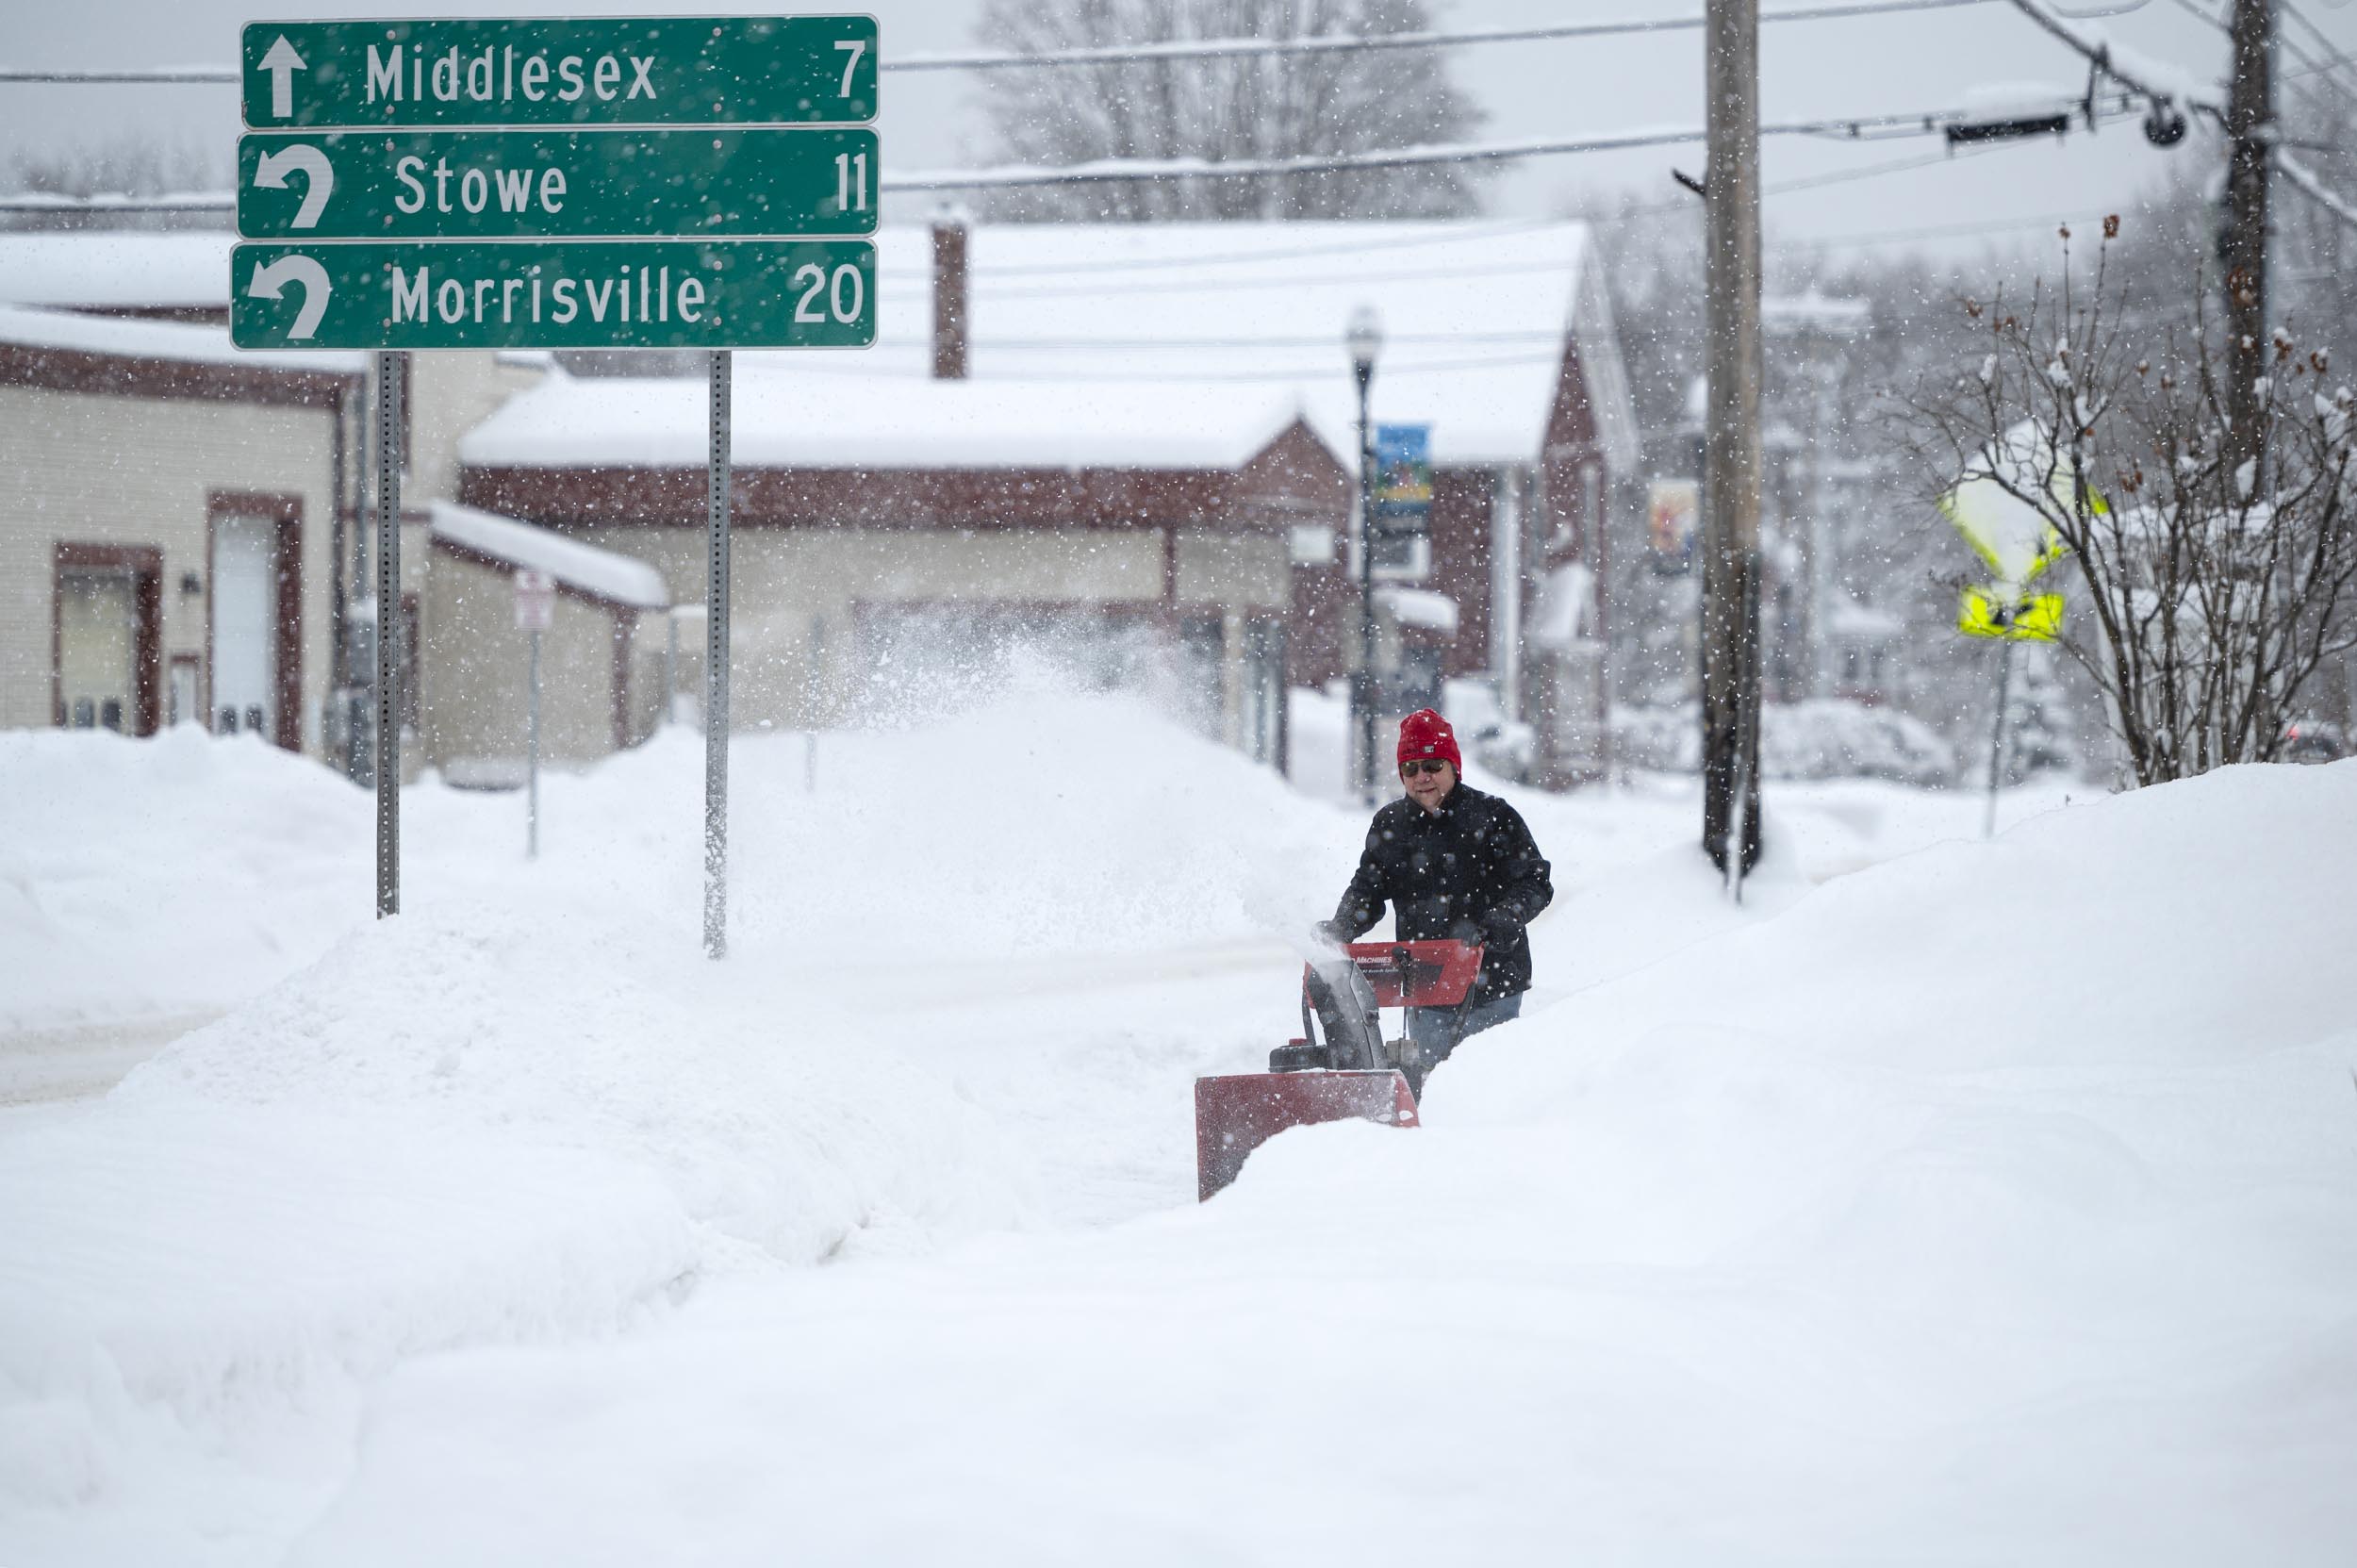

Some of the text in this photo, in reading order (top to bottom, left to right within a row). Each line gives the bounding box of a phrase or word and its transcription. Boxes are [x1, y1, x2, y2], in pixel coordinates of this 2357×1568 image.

[365, 40, 865, 104] Middlesex 7
[394, 153, 867, 214] Stowe 11
[391, 263, 864, 323] Morrisville 20
